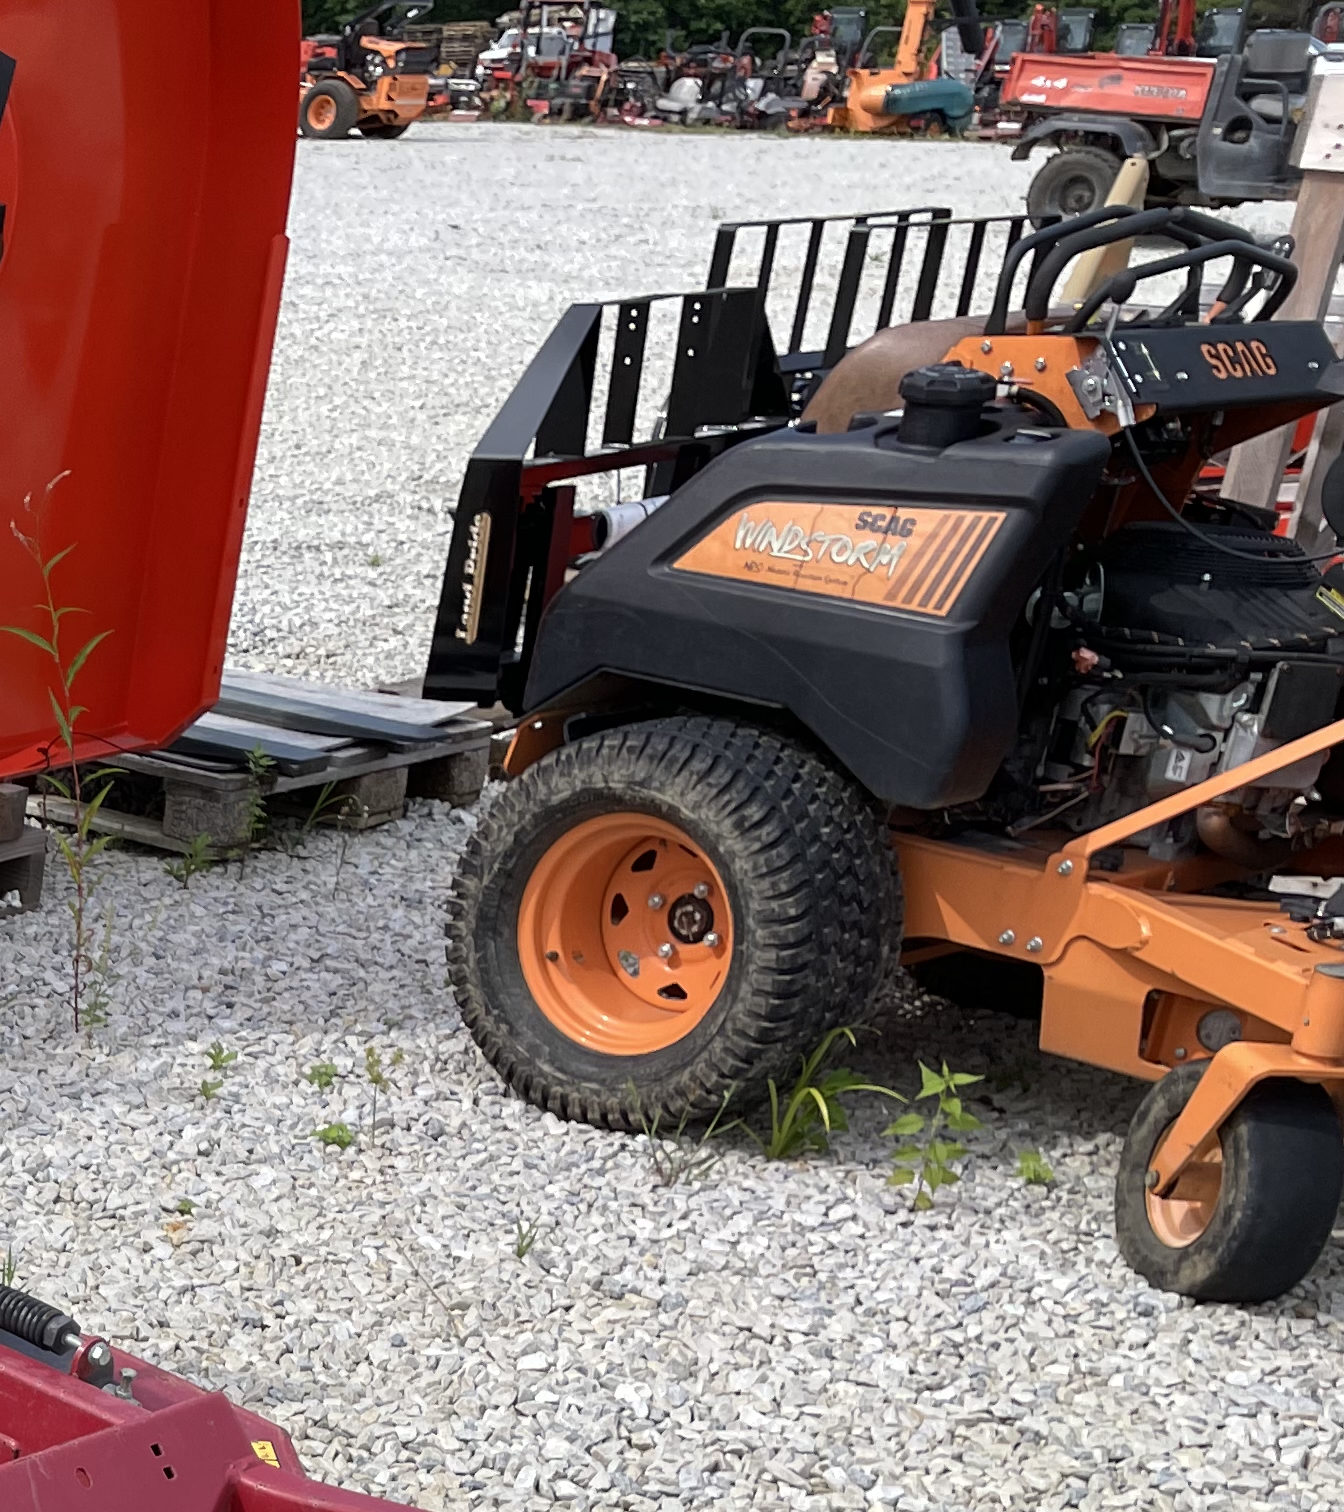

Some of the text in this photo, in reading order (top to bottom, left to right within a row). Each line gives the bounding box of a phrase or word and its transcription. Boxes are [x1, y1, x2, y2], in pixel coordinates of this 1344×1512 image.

[1199, 339, 1278, 380] SCAG
[855, 511, 917, 537] SCAG
[733, 512, 908, 580] WINDSTORM
